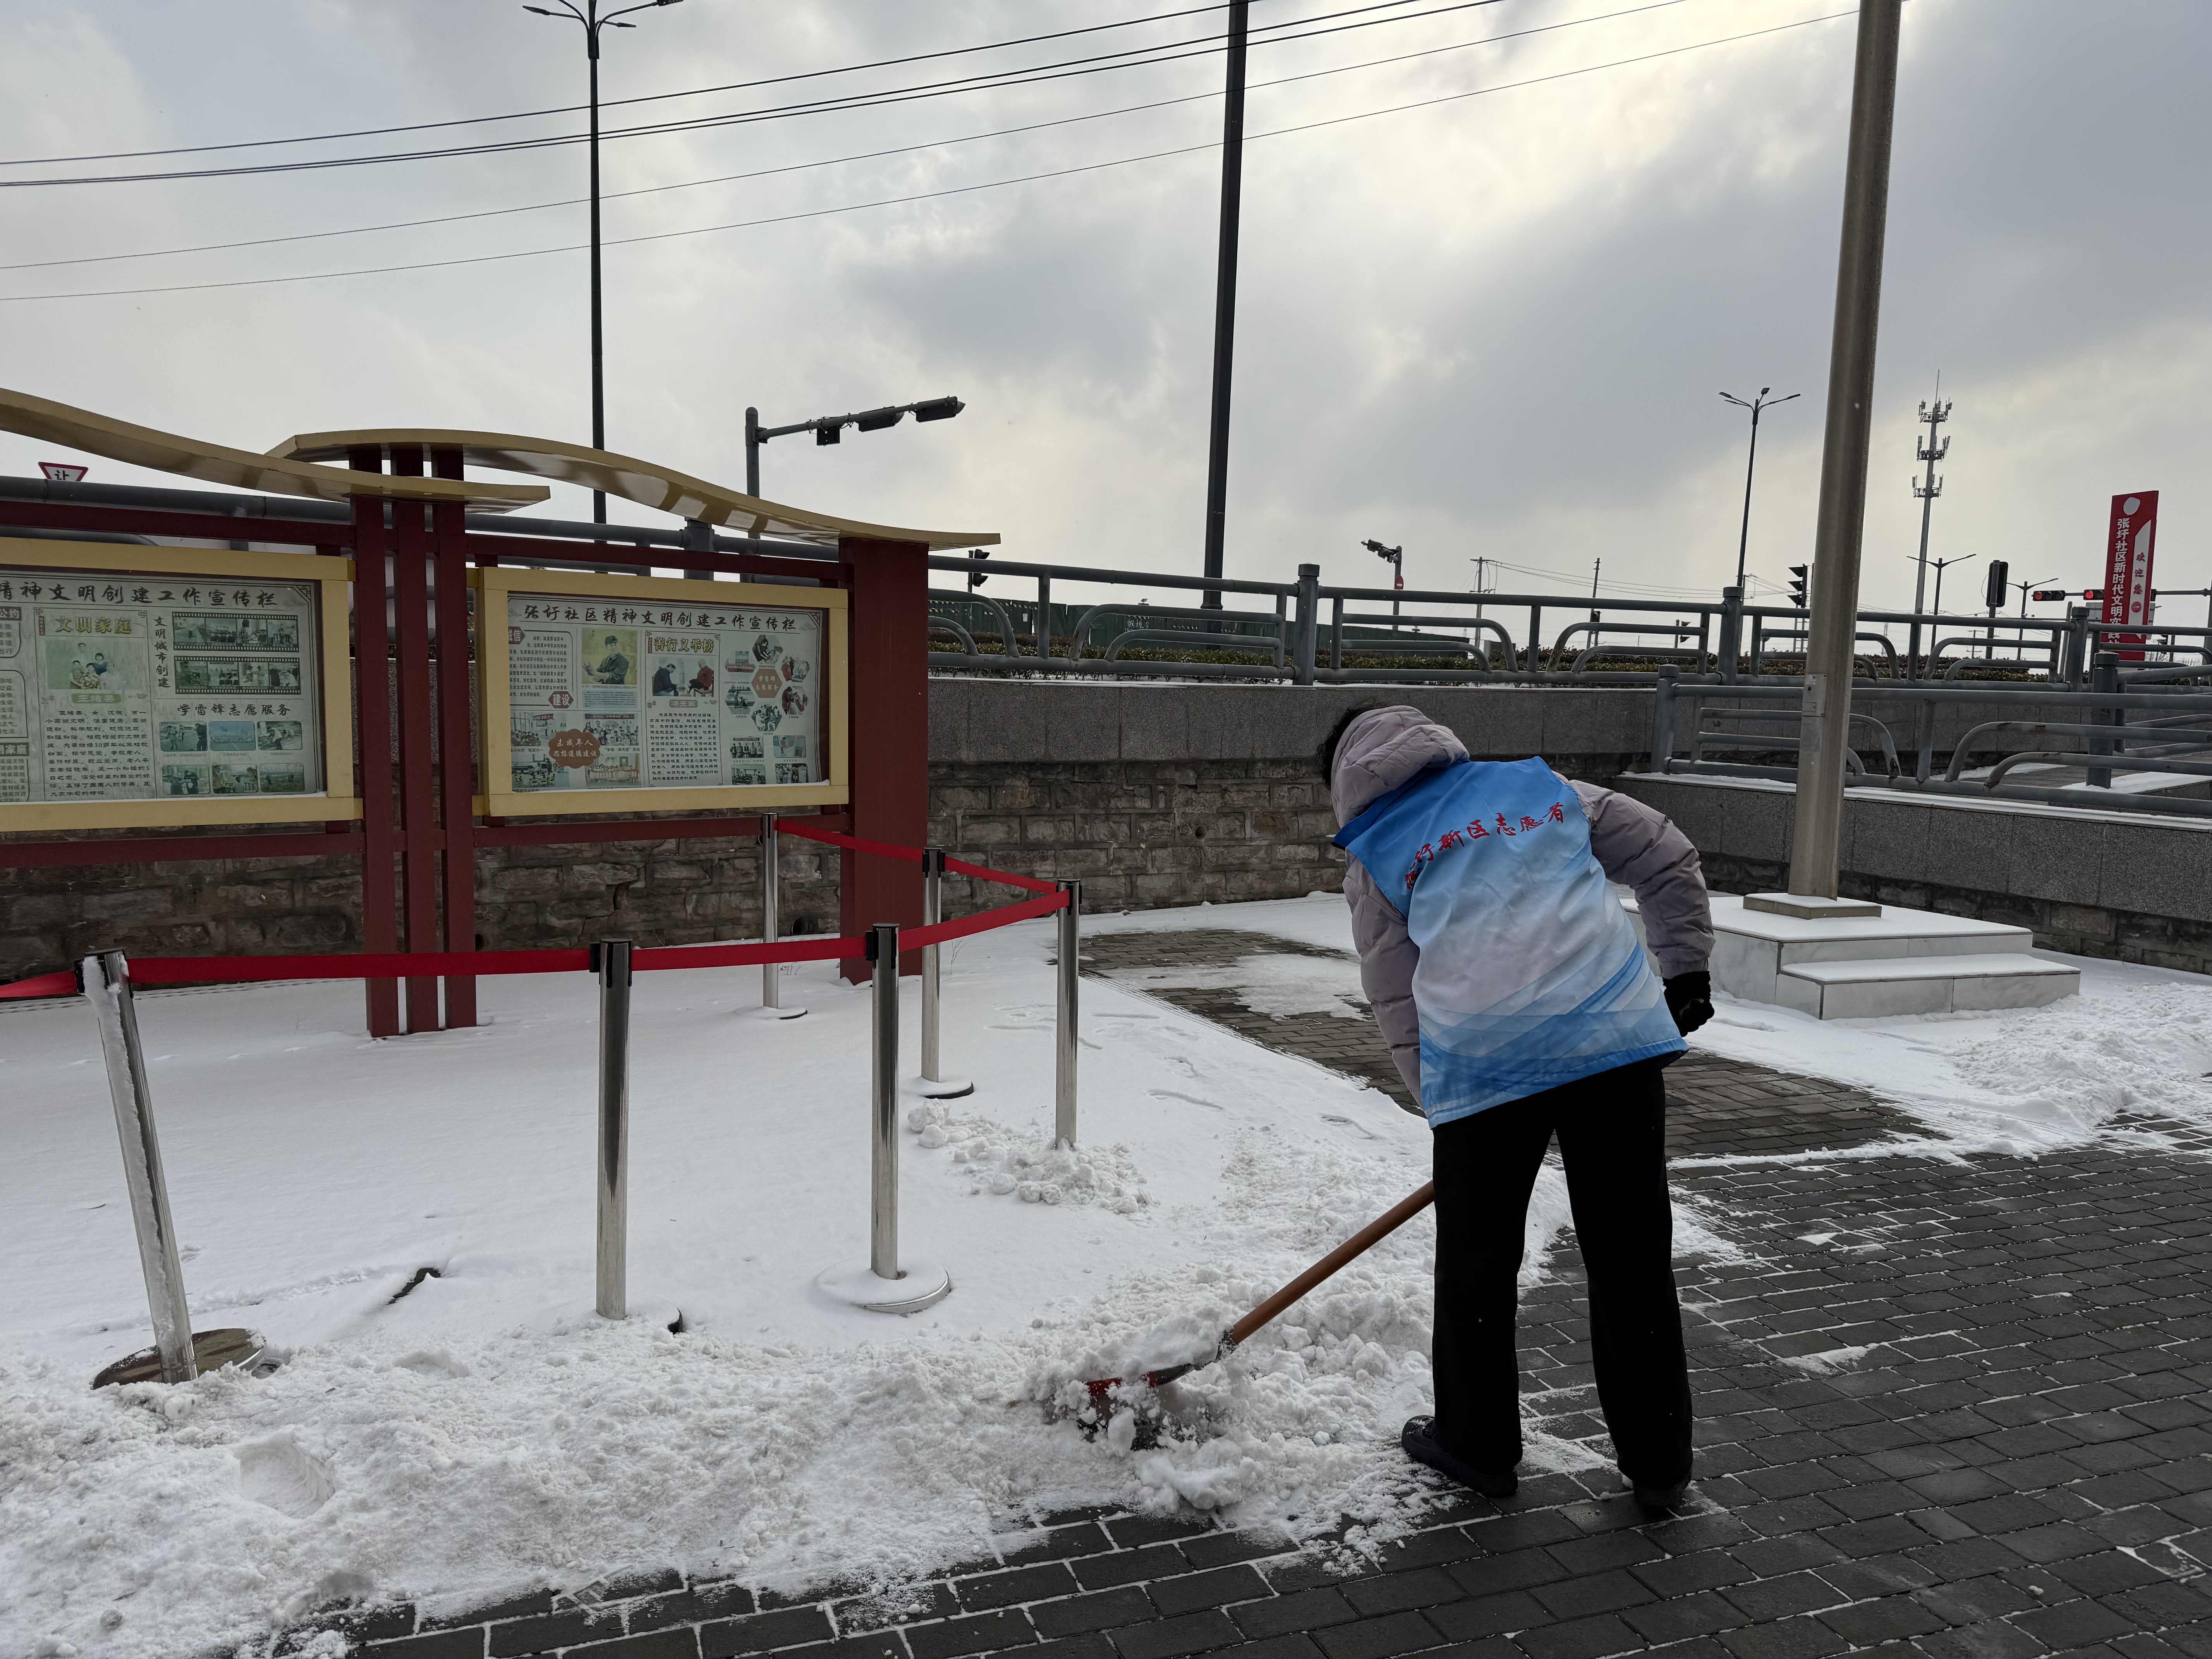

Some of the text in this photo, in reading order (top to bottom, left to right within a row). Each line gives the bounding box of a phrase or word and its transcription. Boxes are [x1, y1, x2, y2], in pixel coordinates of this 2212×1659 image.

[54, 470, 70, 481] 让
[2133, 552, 2146, 594] 欢迎您
[55, 616, 132, 634] 文明家庭
[524, 605, 796, 631] 张圩社区精神文明创建工作宣传栏
[154, 616, 171, 689] 文明城市创建
[654, 637, 714, 653] 善行义举榜
[553, 694, 570, 706] 建设
[177, 703, 291, 716] 学雷锋志愿服务
[557, 738, 593, 747] 未成年人
